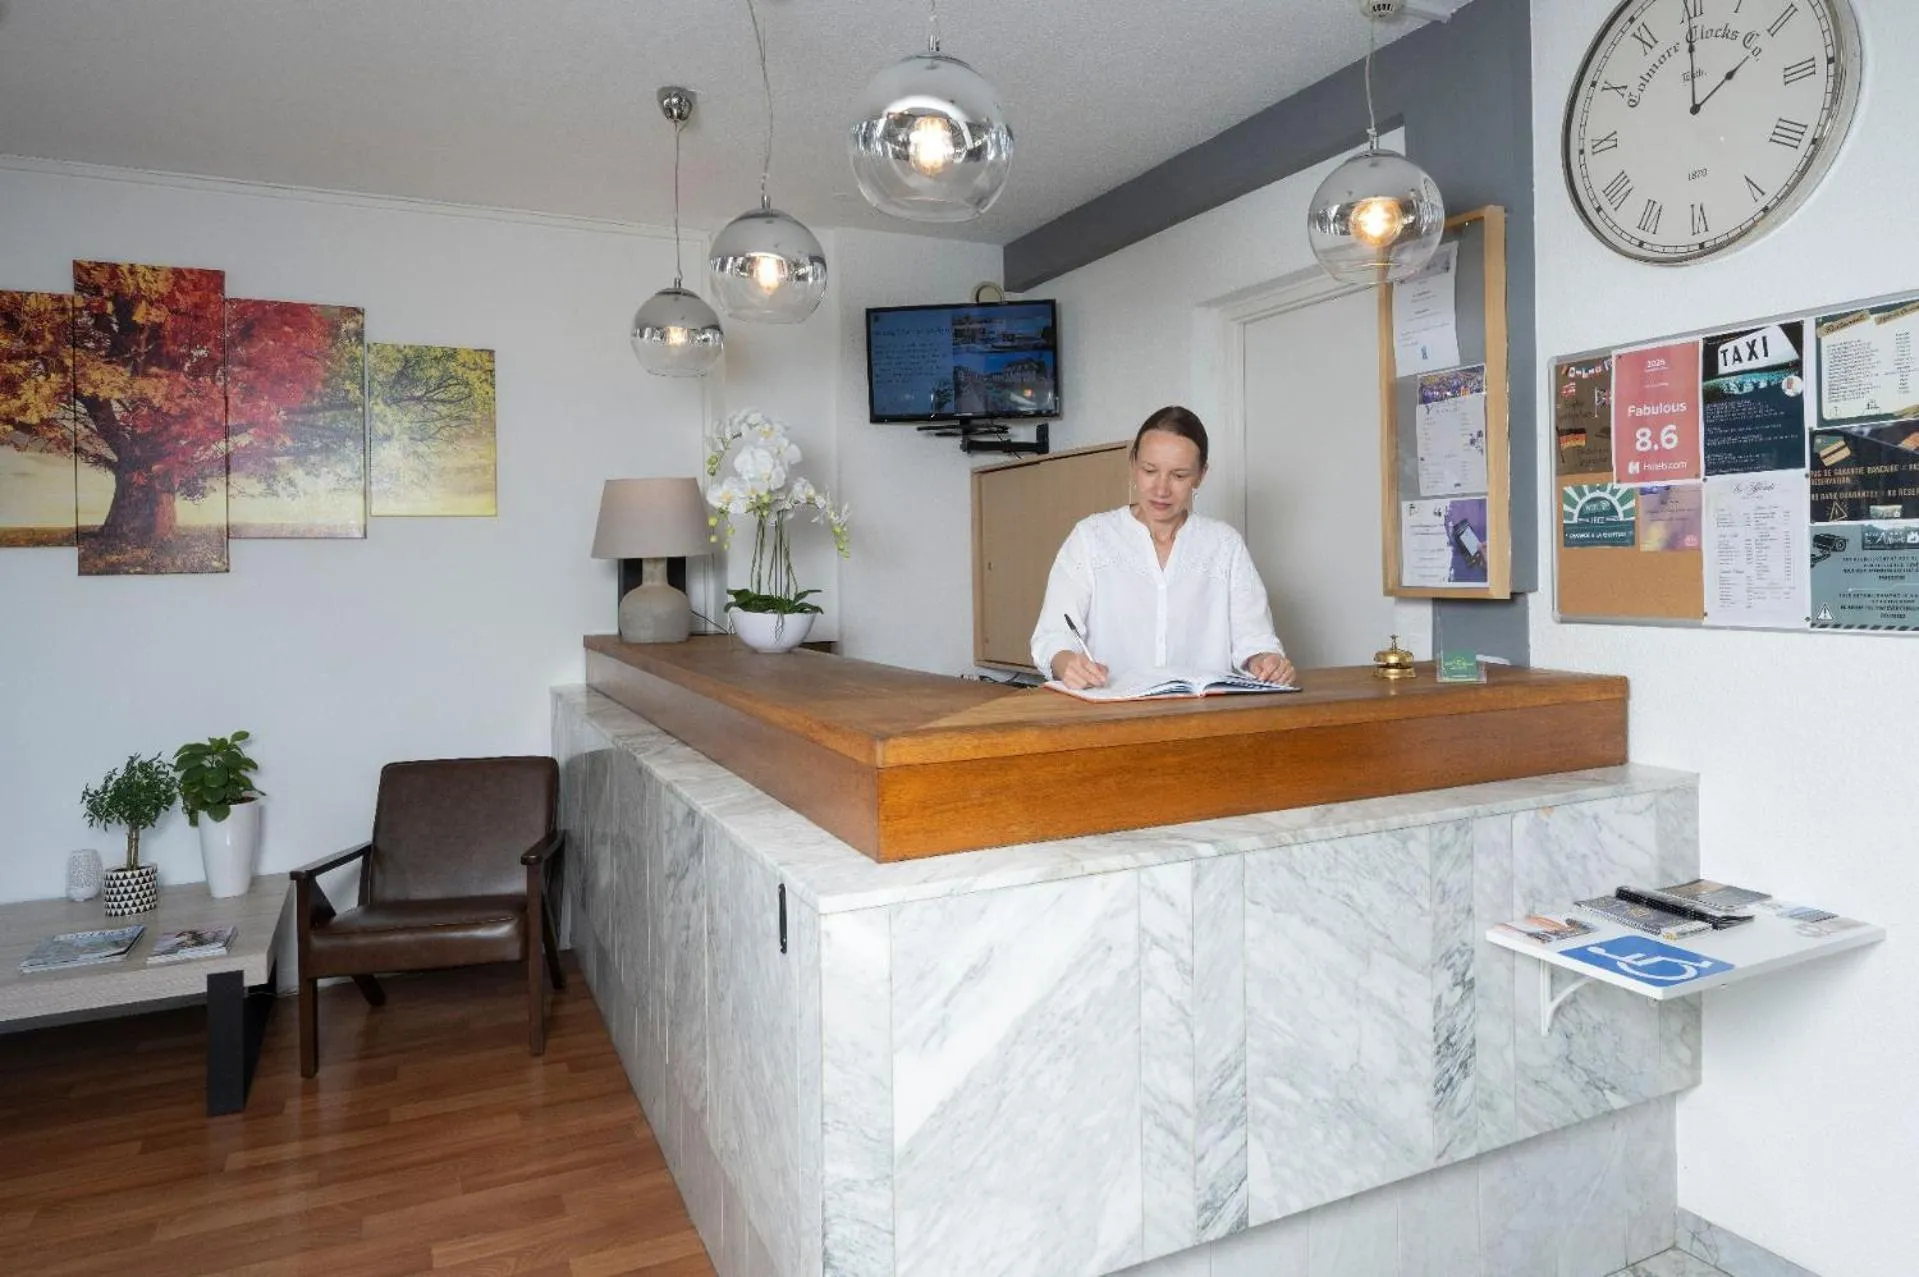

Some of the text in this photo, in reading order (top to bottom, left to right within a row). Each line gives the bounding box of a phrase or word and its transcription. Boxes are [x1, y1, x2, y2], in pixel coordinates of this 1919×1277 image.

[1685, 22, 1740, 44] Clocks
[1719, 335, 1769, 367] TAXI
[1627, 401, 1687, 417] Fabulous
[1635, 424, 1679, 452] 8.6
